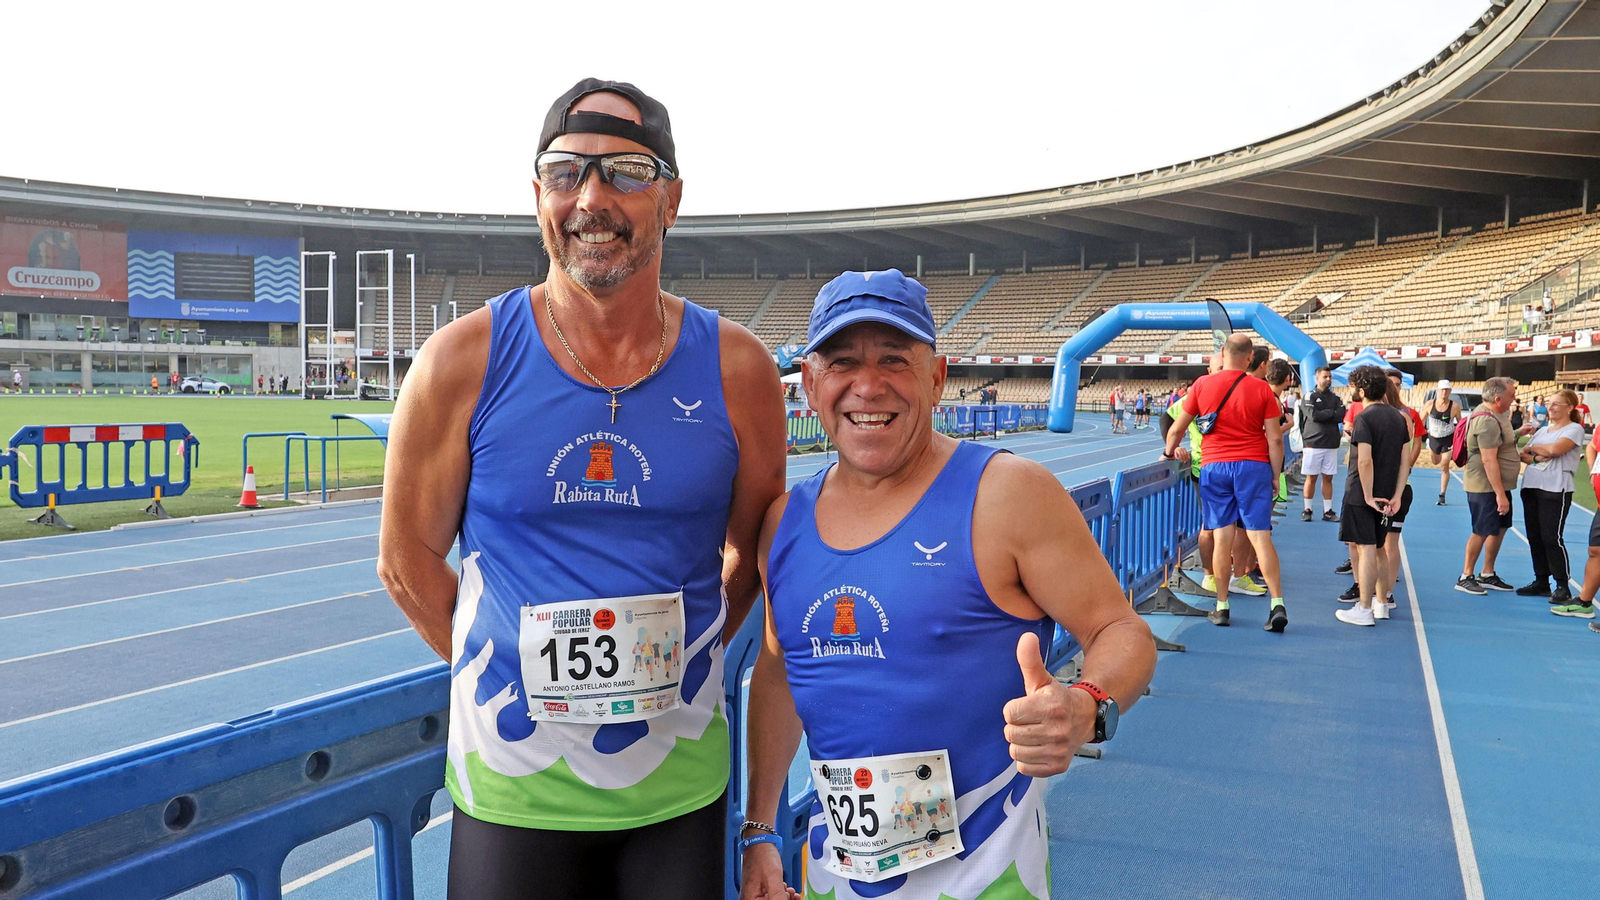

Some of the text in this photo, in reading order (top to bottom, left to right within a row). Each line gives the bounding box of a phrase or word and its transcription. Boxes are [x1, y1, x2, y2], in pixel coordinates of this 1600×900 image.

[5, 216, 60, 226] BIENVENIDOS
[15, 271, 94, 289] Cruzcampo
[546, 430, 652, 482] UNIÓN ATLÉTICA ROTEÑA
[553, 480, 641, 507] Rabita RutA
[536, 608, 591, 622] XLII CARRERA
[801, 584, 889, 634] UNIÓN ATLÉTICA ROTEÑA
[552, 617, 591, 628] POPULAR
[810, 636, 886, 659] Rabita RutA
[540, 634, 619, 682] 153
[571, 682, 612, 691] CASTELLANO
[613, 680, 635, 688] RAMOS
[828, 768, 852, 777] ARRERA
[828, 776, 853, 786] POPULAR
[827, 793, 880, 837] 625
[872, 838, 889, 847] NEVA
